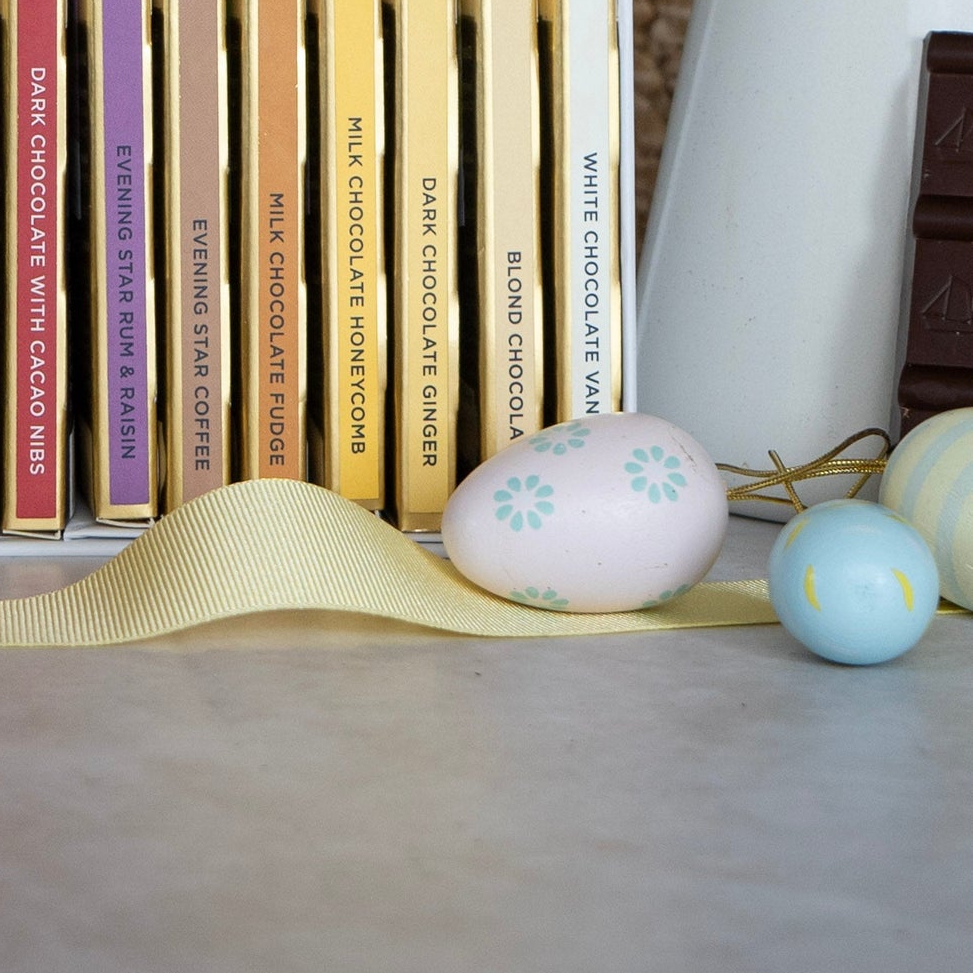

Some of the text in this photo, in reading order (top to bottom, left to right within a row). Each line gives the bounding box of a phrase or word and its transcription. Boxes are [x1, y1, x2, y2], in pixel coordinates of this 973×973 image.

[29, 67, 46, 475] DARK CHOCOLATE WITH CACAO NIBS
[116, 145, 136, 459] EVENING STAR RUM & RAISIN
[192, 219, 210, 471] EVENING STAR COFFEE
[269, 193, 285, 466] MILK CHOCOLATE FUDGE
[347, 117, 366, 455] MILK CHOCOLATE HONEYCOMB
[422, 177, 438, 467] DARK CHOCOLATE GINGER
[507, 251, 524, 440] BLOND CHOCOLA
[583, 152, 600, 413] WHITE CHOCOLATE VAN
